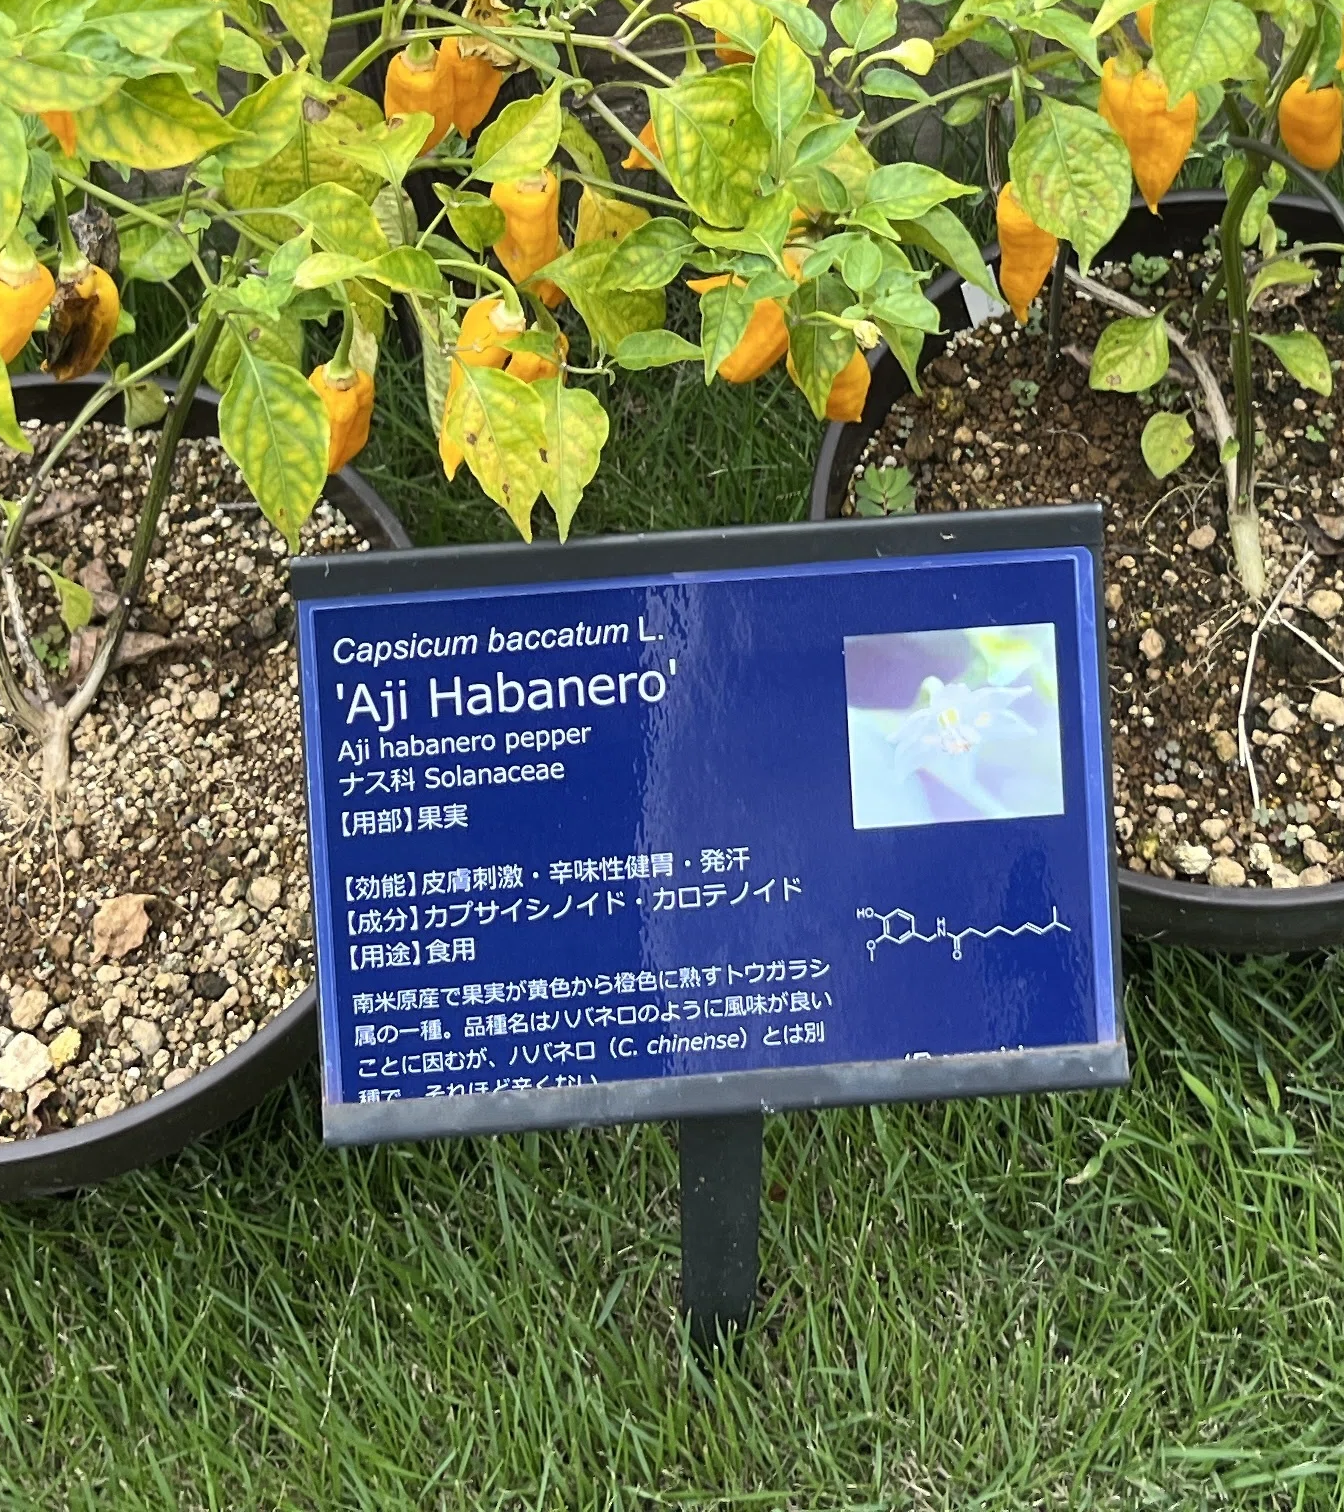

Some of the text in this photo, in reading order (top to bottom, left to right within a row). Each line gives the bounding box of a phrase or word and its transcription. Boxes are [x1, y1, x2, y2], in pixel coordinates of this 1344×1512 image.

[332, 616, 664, 667] Capsicum baccatum L.
[336, 658, 677, 732] 'Aji Habanero'
[338, 724, 592, 766] Aji habanero pepper
[339, 760, 565, 797] ナス科 Solanaceae
[341, 803, 469, 839] 【用部】果実
[350, 936, 476, 971] 【用途】食用
